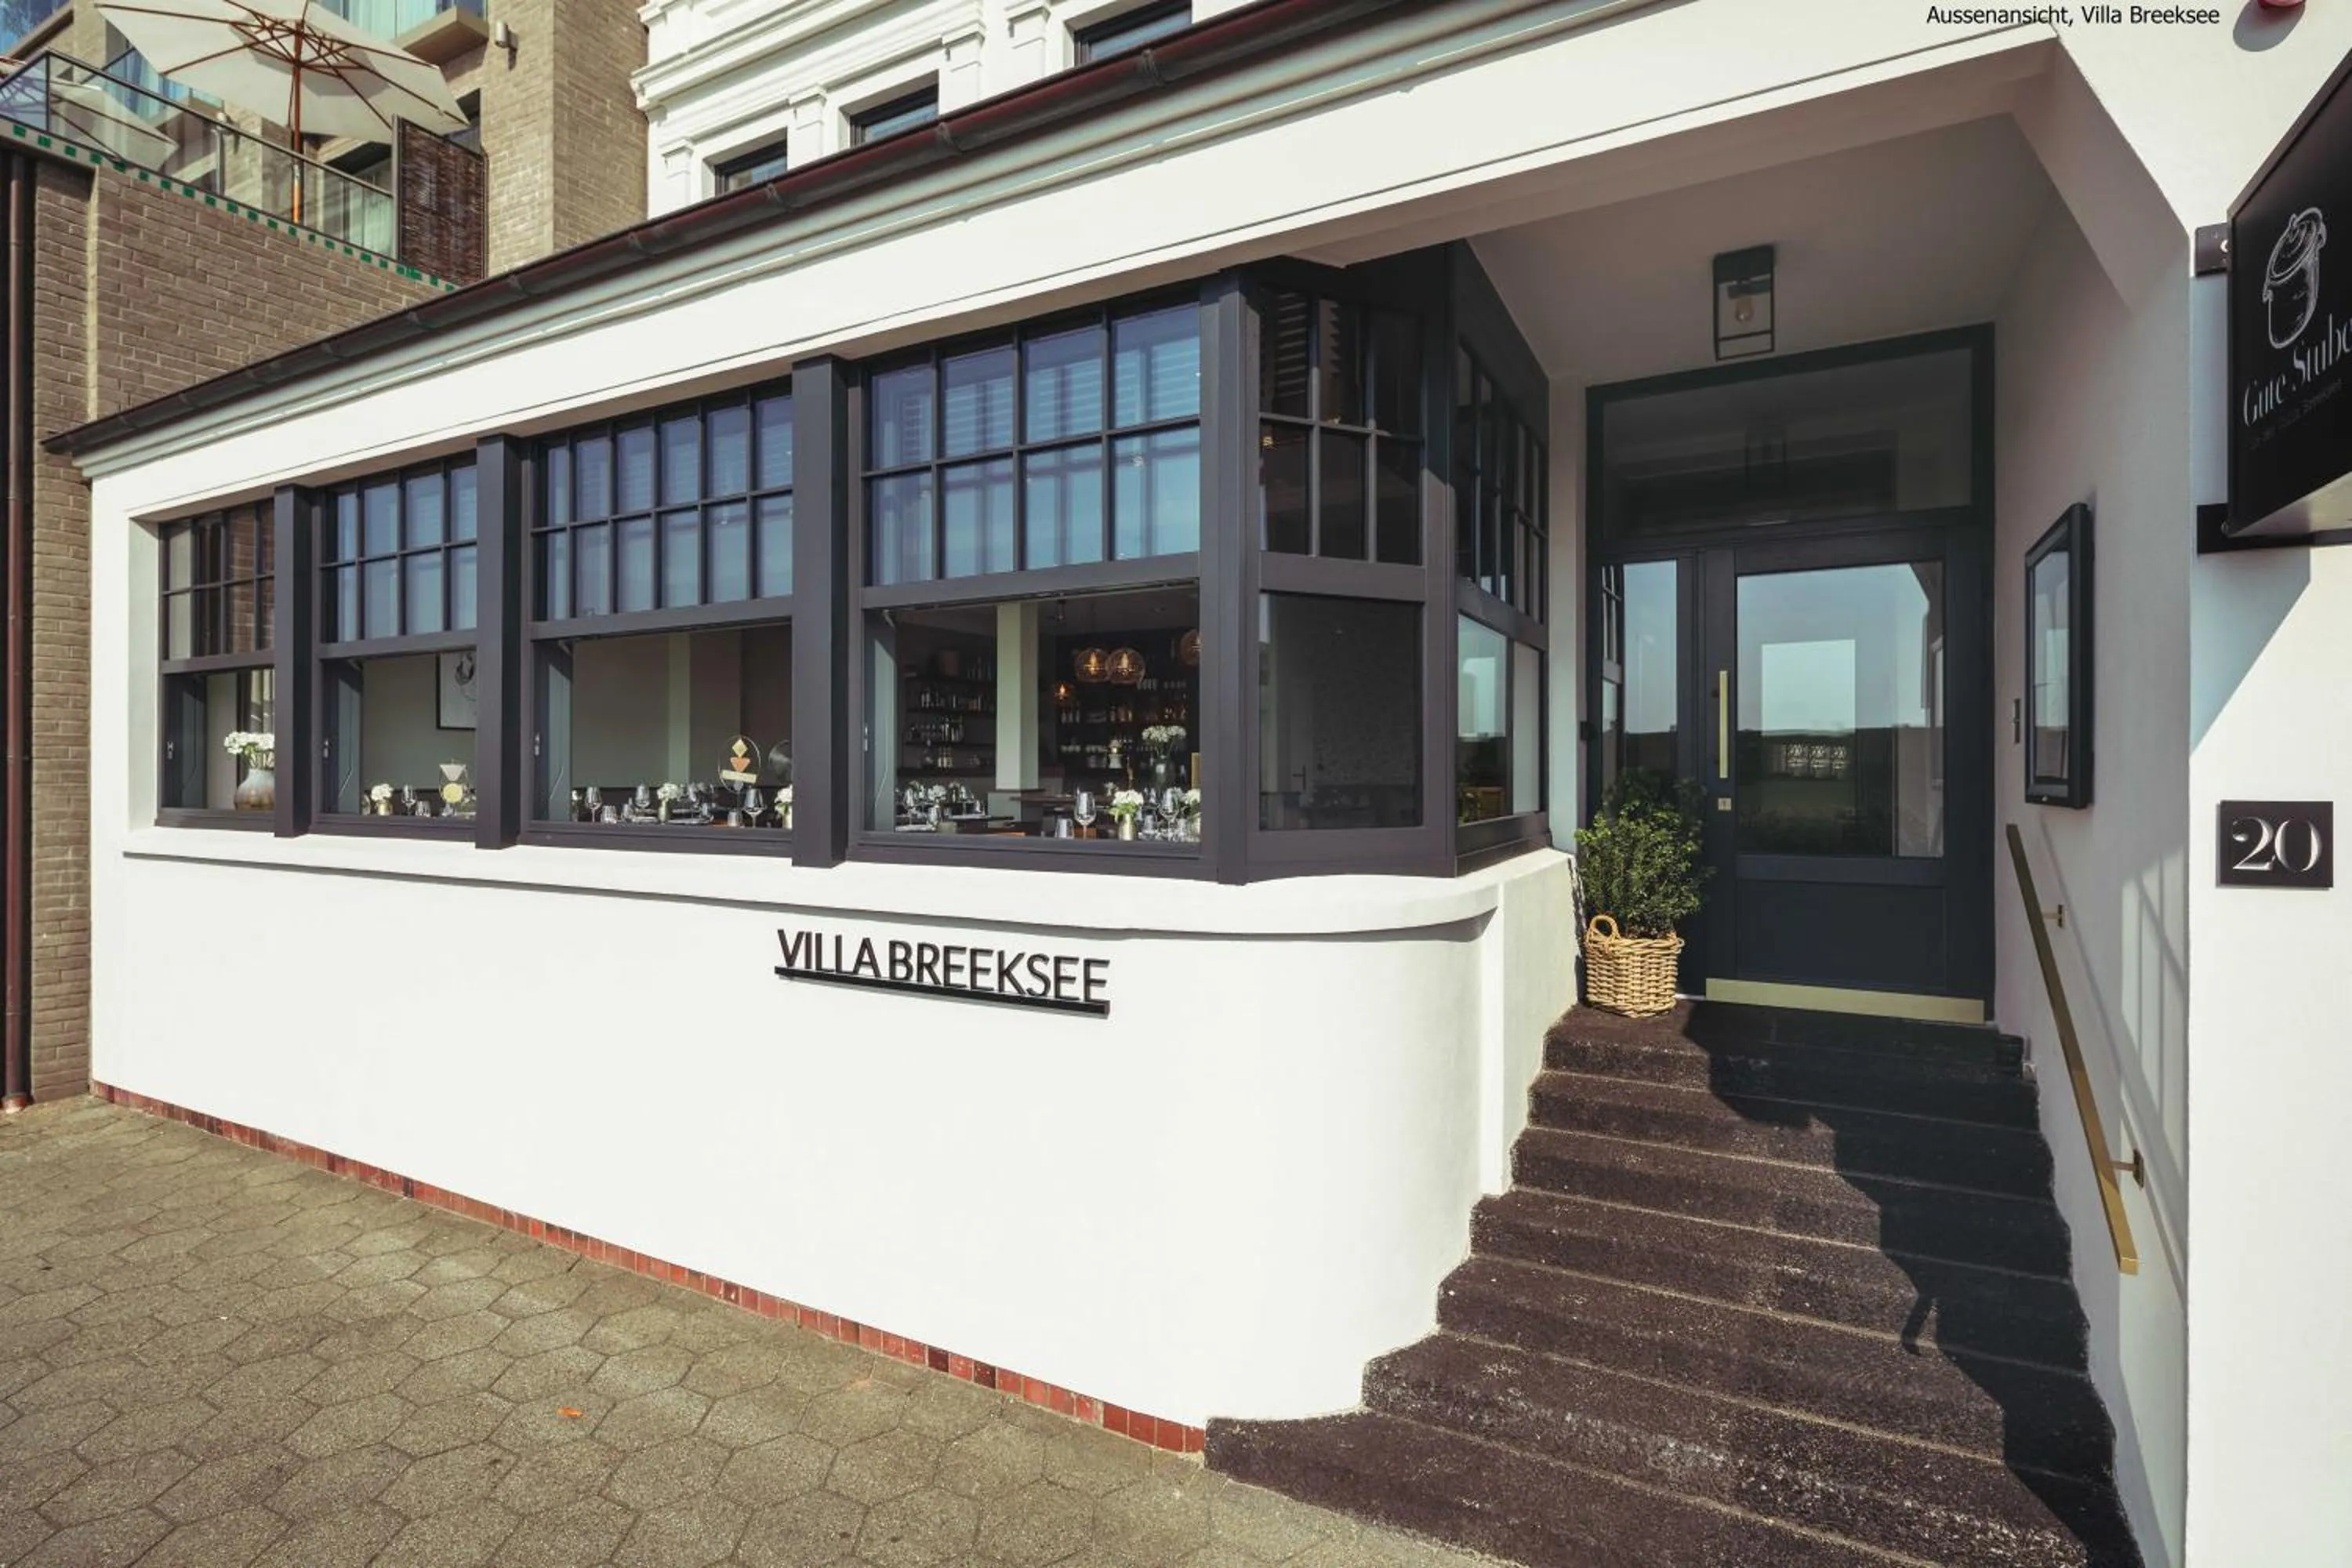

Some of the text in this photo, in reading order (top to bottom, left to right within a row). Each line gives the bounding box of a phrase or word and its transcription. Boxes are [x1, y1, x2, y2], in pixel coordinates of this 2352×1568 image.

[2232, 815, 2323, 873] 20
[777, 928, 1111, 1004] VILLA BREEKSEE
